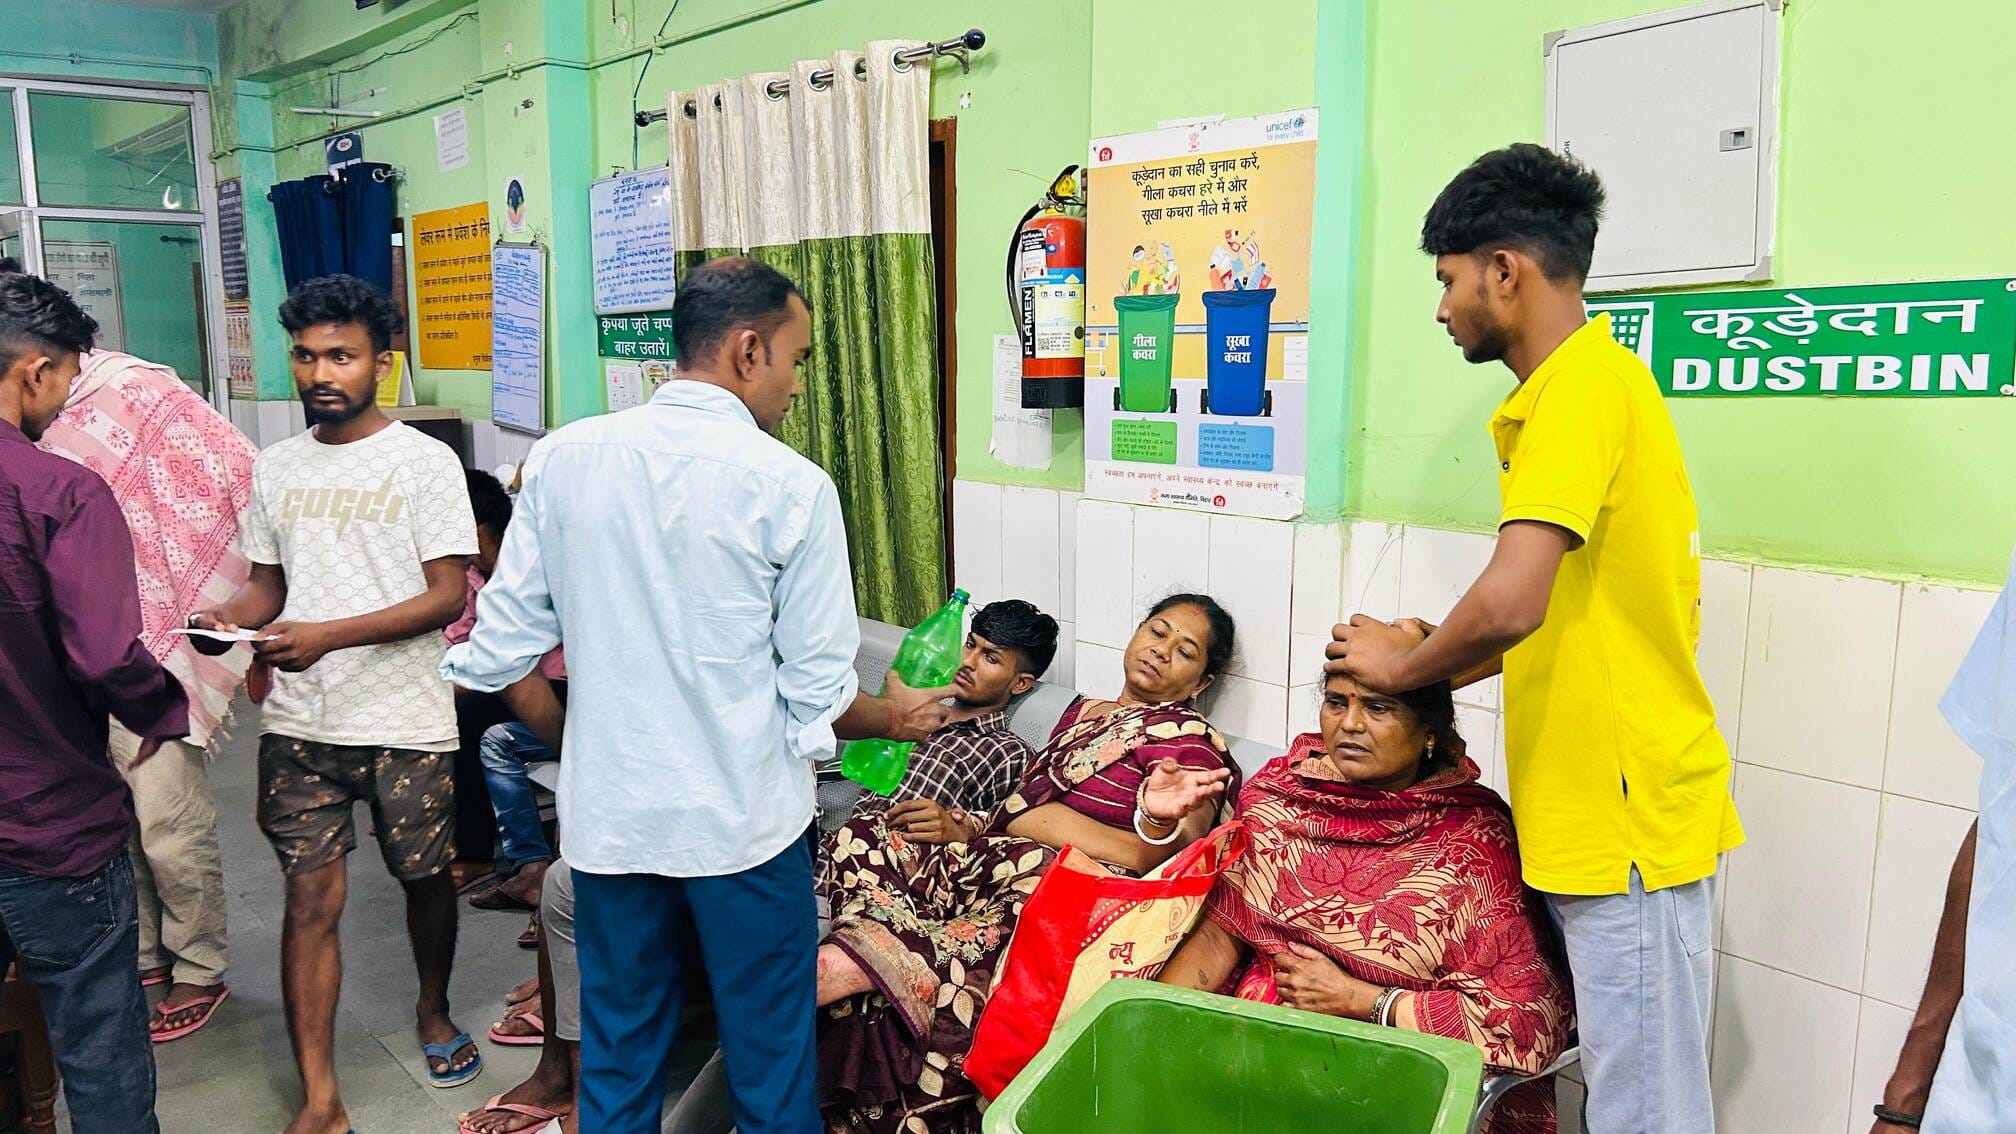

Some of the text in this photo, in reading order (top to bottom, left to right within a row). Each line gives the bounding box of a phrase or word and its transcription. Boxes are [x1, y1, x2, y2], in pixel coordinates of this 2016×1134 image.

[1266, 118, 1292, 132] unicef
[1132, 152, 1259, 186] कूड़ेदान का सही चुनाव करें,
[1142, 185, 1164, 200] गीला
[1168, 185, 1195, 198] कचरा
[1200, 179, 1212, 196] हरे
[1228, 176, 1247, 192] और
[1142, 196, 1247, 225] सूखा कचरा नीले में भरें
[601, 314, 672, 336] कृपया जूते चप्प
[1024, 290, 1032, 355] FLAMEN
[1683, 292, 1984, 350] कूड़ेदान
[614, 337, 669, 356] बाहर उतारें।
[1133, 334, 1157, 346] गीला
[1226, 336, 1250, 351] सूखा
[1132, 350, 1157, 360] कचरा
[1224, 352, 1251, 363] कचरा
[1672, 354, 1990, 391] DUSTBIN
[1167, 473, 1179, 481] अपने
[1224, 478, 1232, 486] को
[1109, 942, 1136, 965] न्यू
